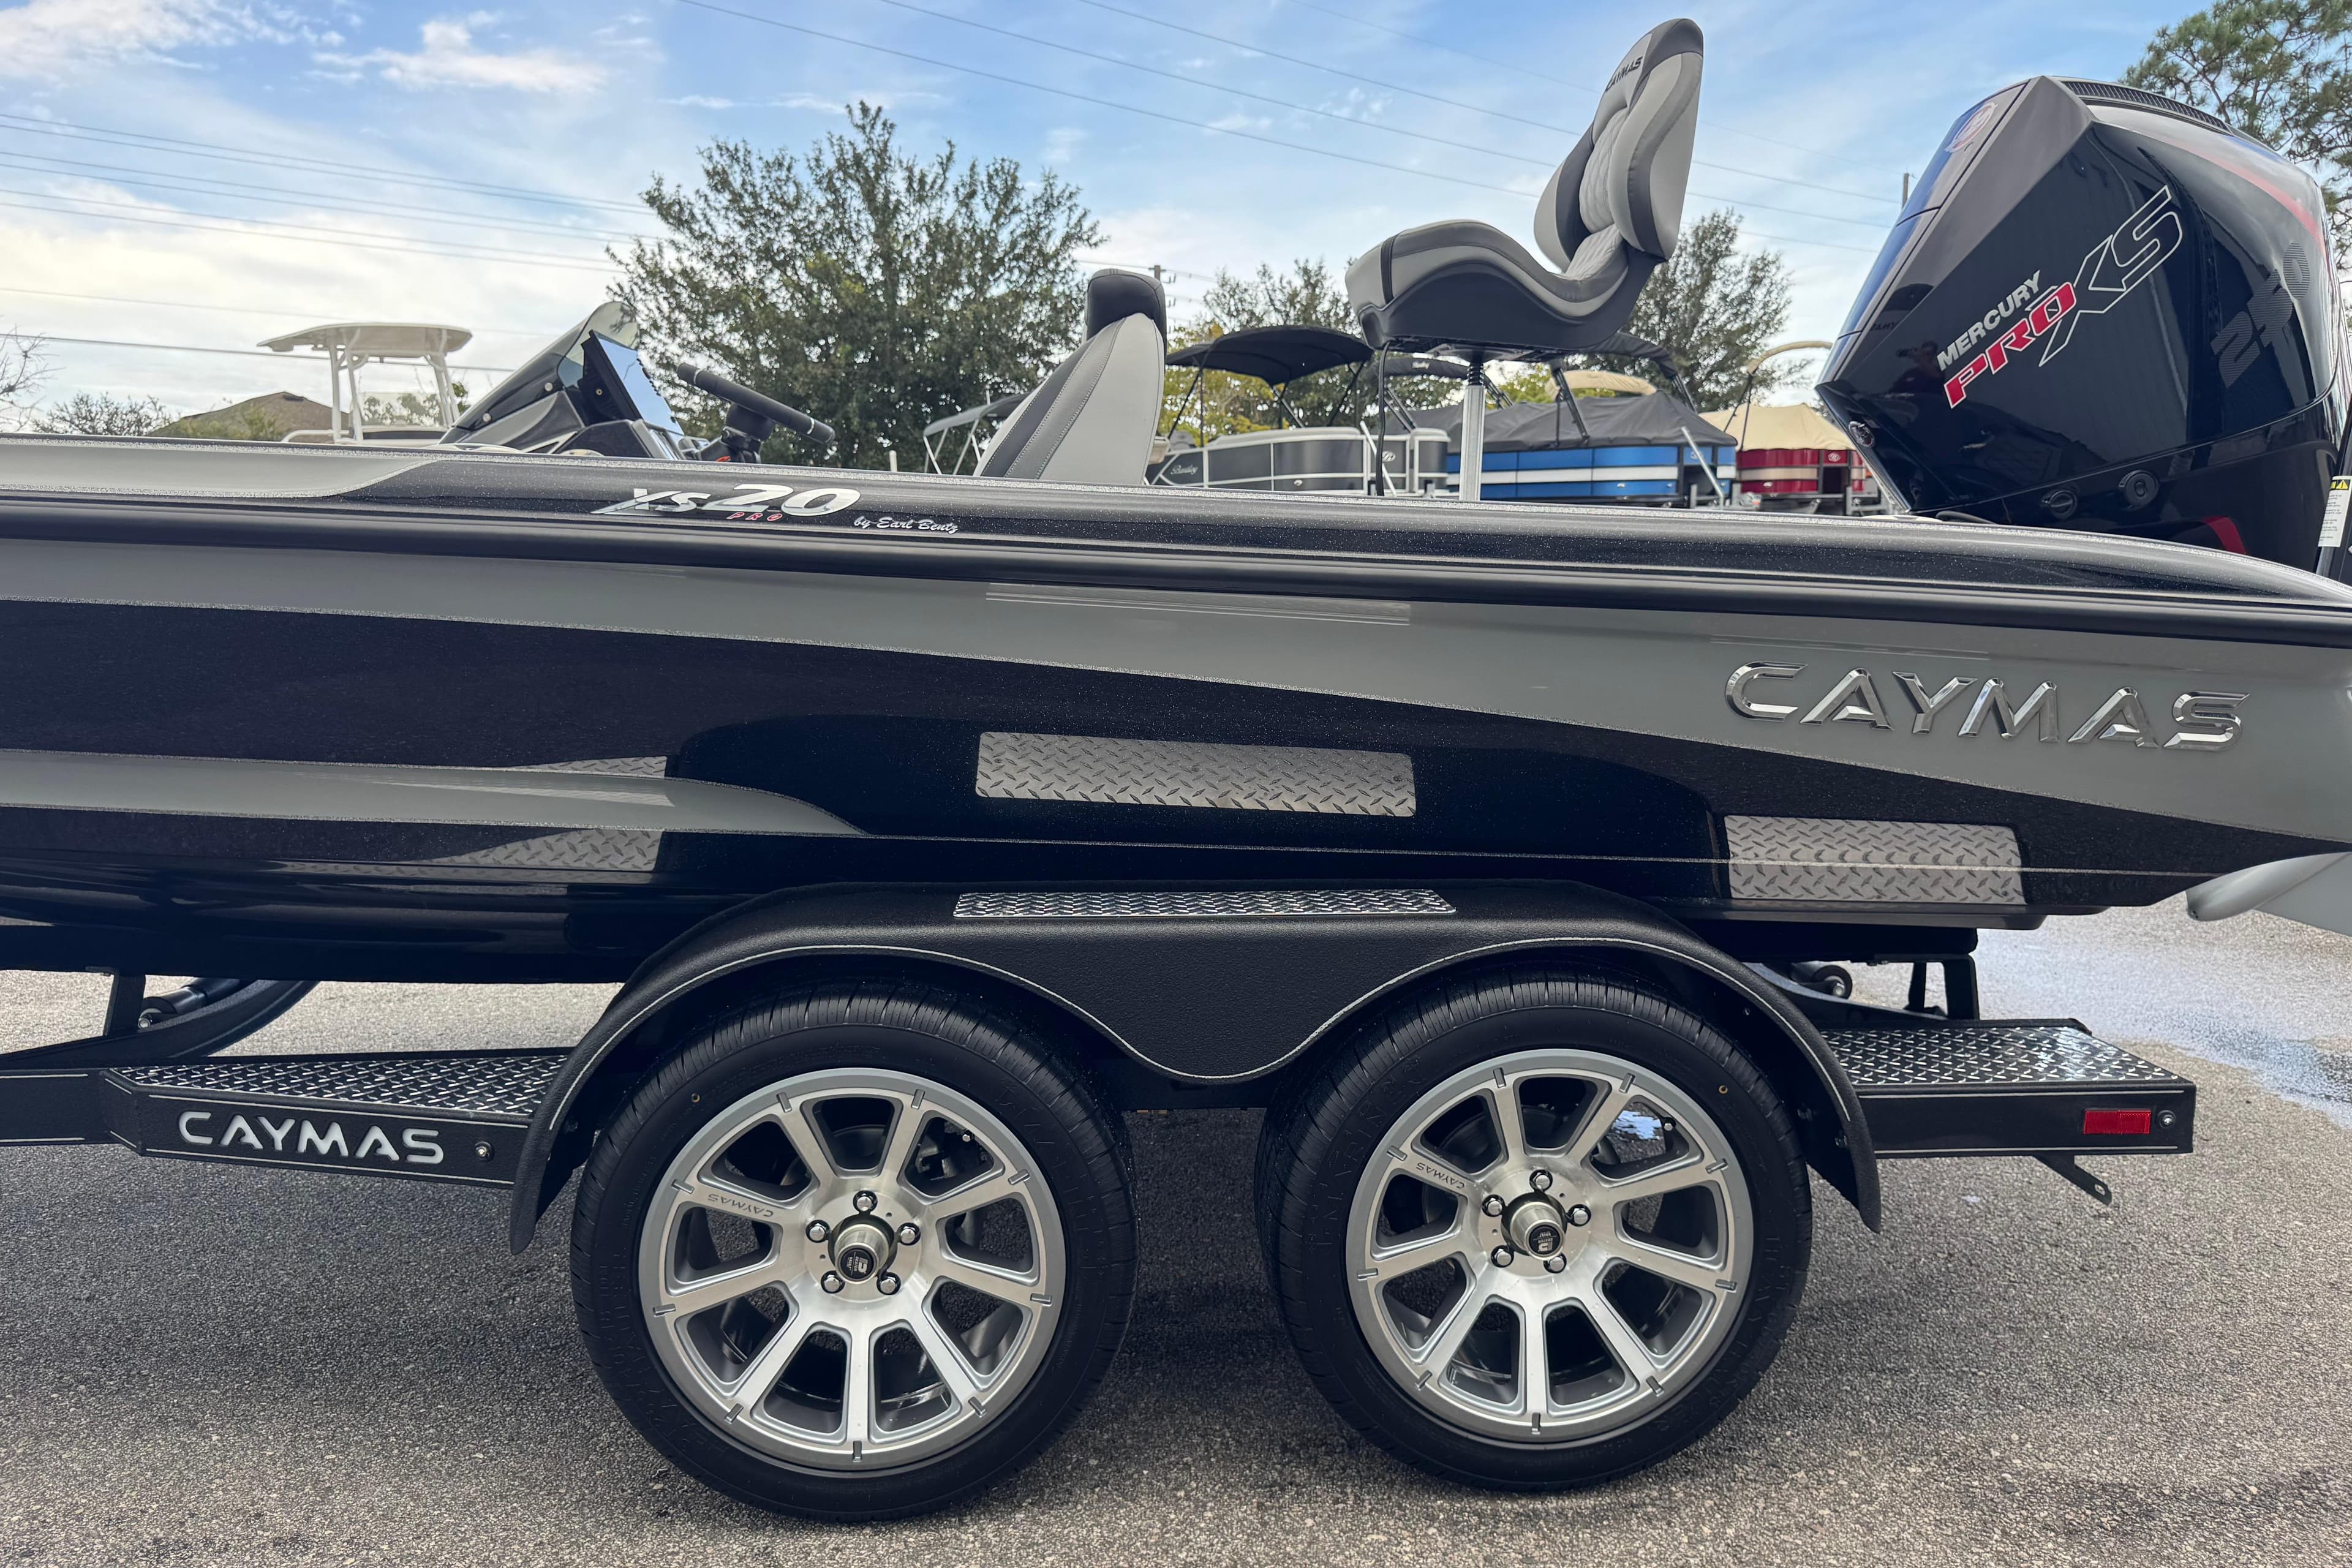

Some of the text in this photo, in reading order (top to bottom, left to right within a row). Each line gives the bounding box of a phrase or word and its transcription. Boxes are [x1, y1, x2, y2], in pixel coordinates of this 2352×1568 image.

[1937, 270, 2040, 371] MERCURY
[726, 511, 783, 521] PRO
[853, 516, 959, 534] by Earl Bentz
[1724, 660, 2251, 751] CAYMAS
[178, 1110, 444, 1164] CAYMAS
[1415, 1162, 1465, 1189] CAYMAS
[707, 1194, 774, 1218] CAYMAS
